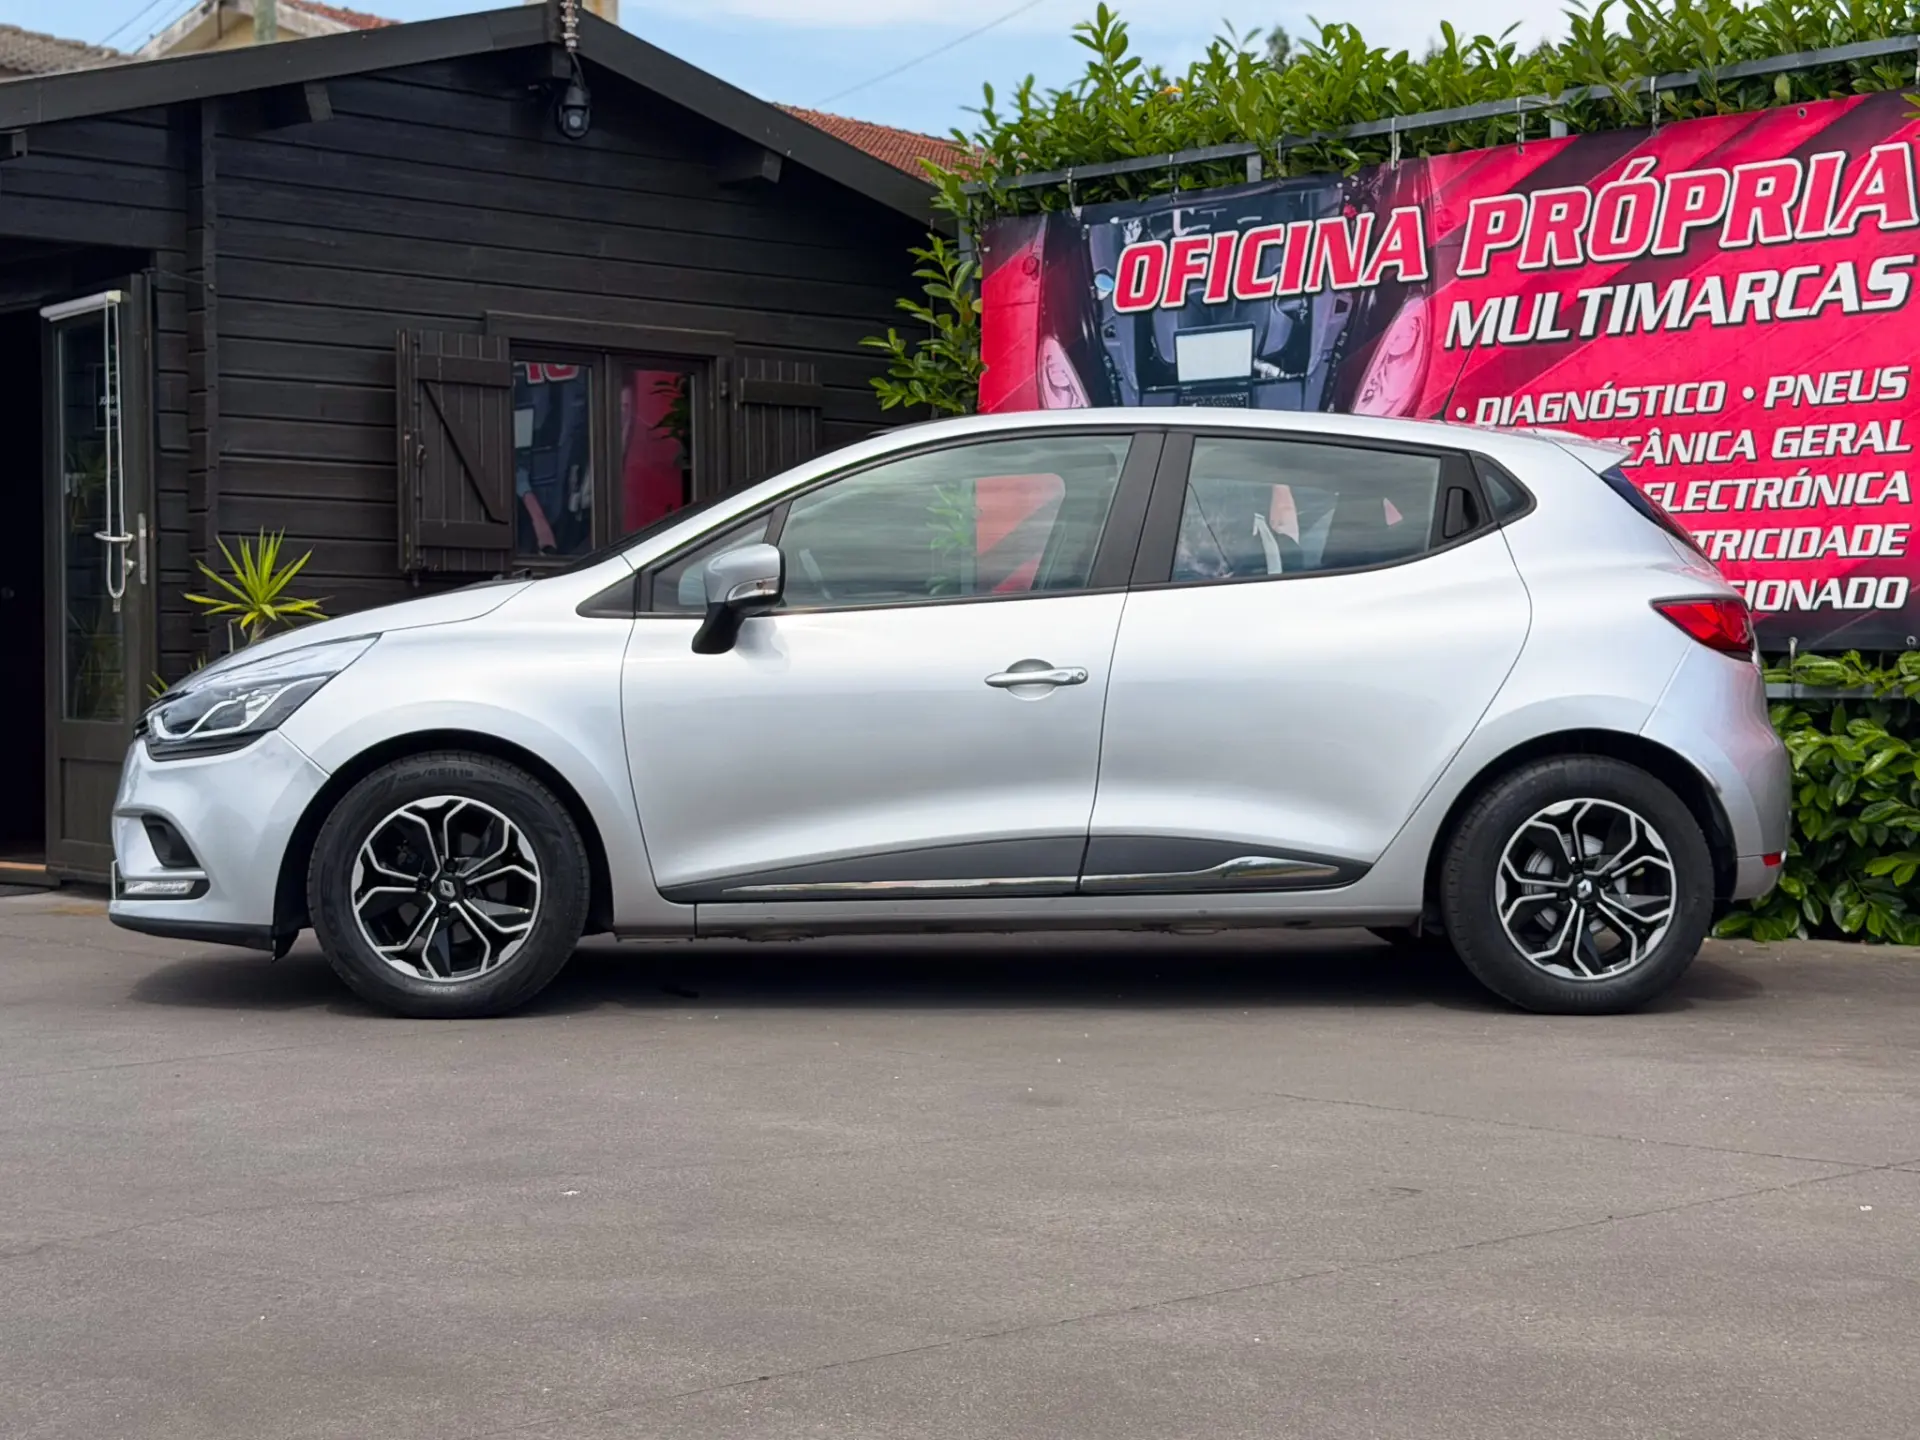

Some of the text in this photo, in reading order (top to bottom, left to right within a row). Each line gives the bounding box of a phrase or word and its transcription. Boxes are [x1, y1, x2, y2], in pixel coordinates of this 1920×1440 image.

[1113, 142, 1919, 312] OFICINA PRÓPRIA
[1444, 255, 1914, 348] MULTIMARCAS
[1475, 366, 1910, 426] DIAGNÓSTICO PNEUS
[1606, 420, 1911, 467] CÂNICA GERAL
[1730, 577, 1909, 612] IONADO
